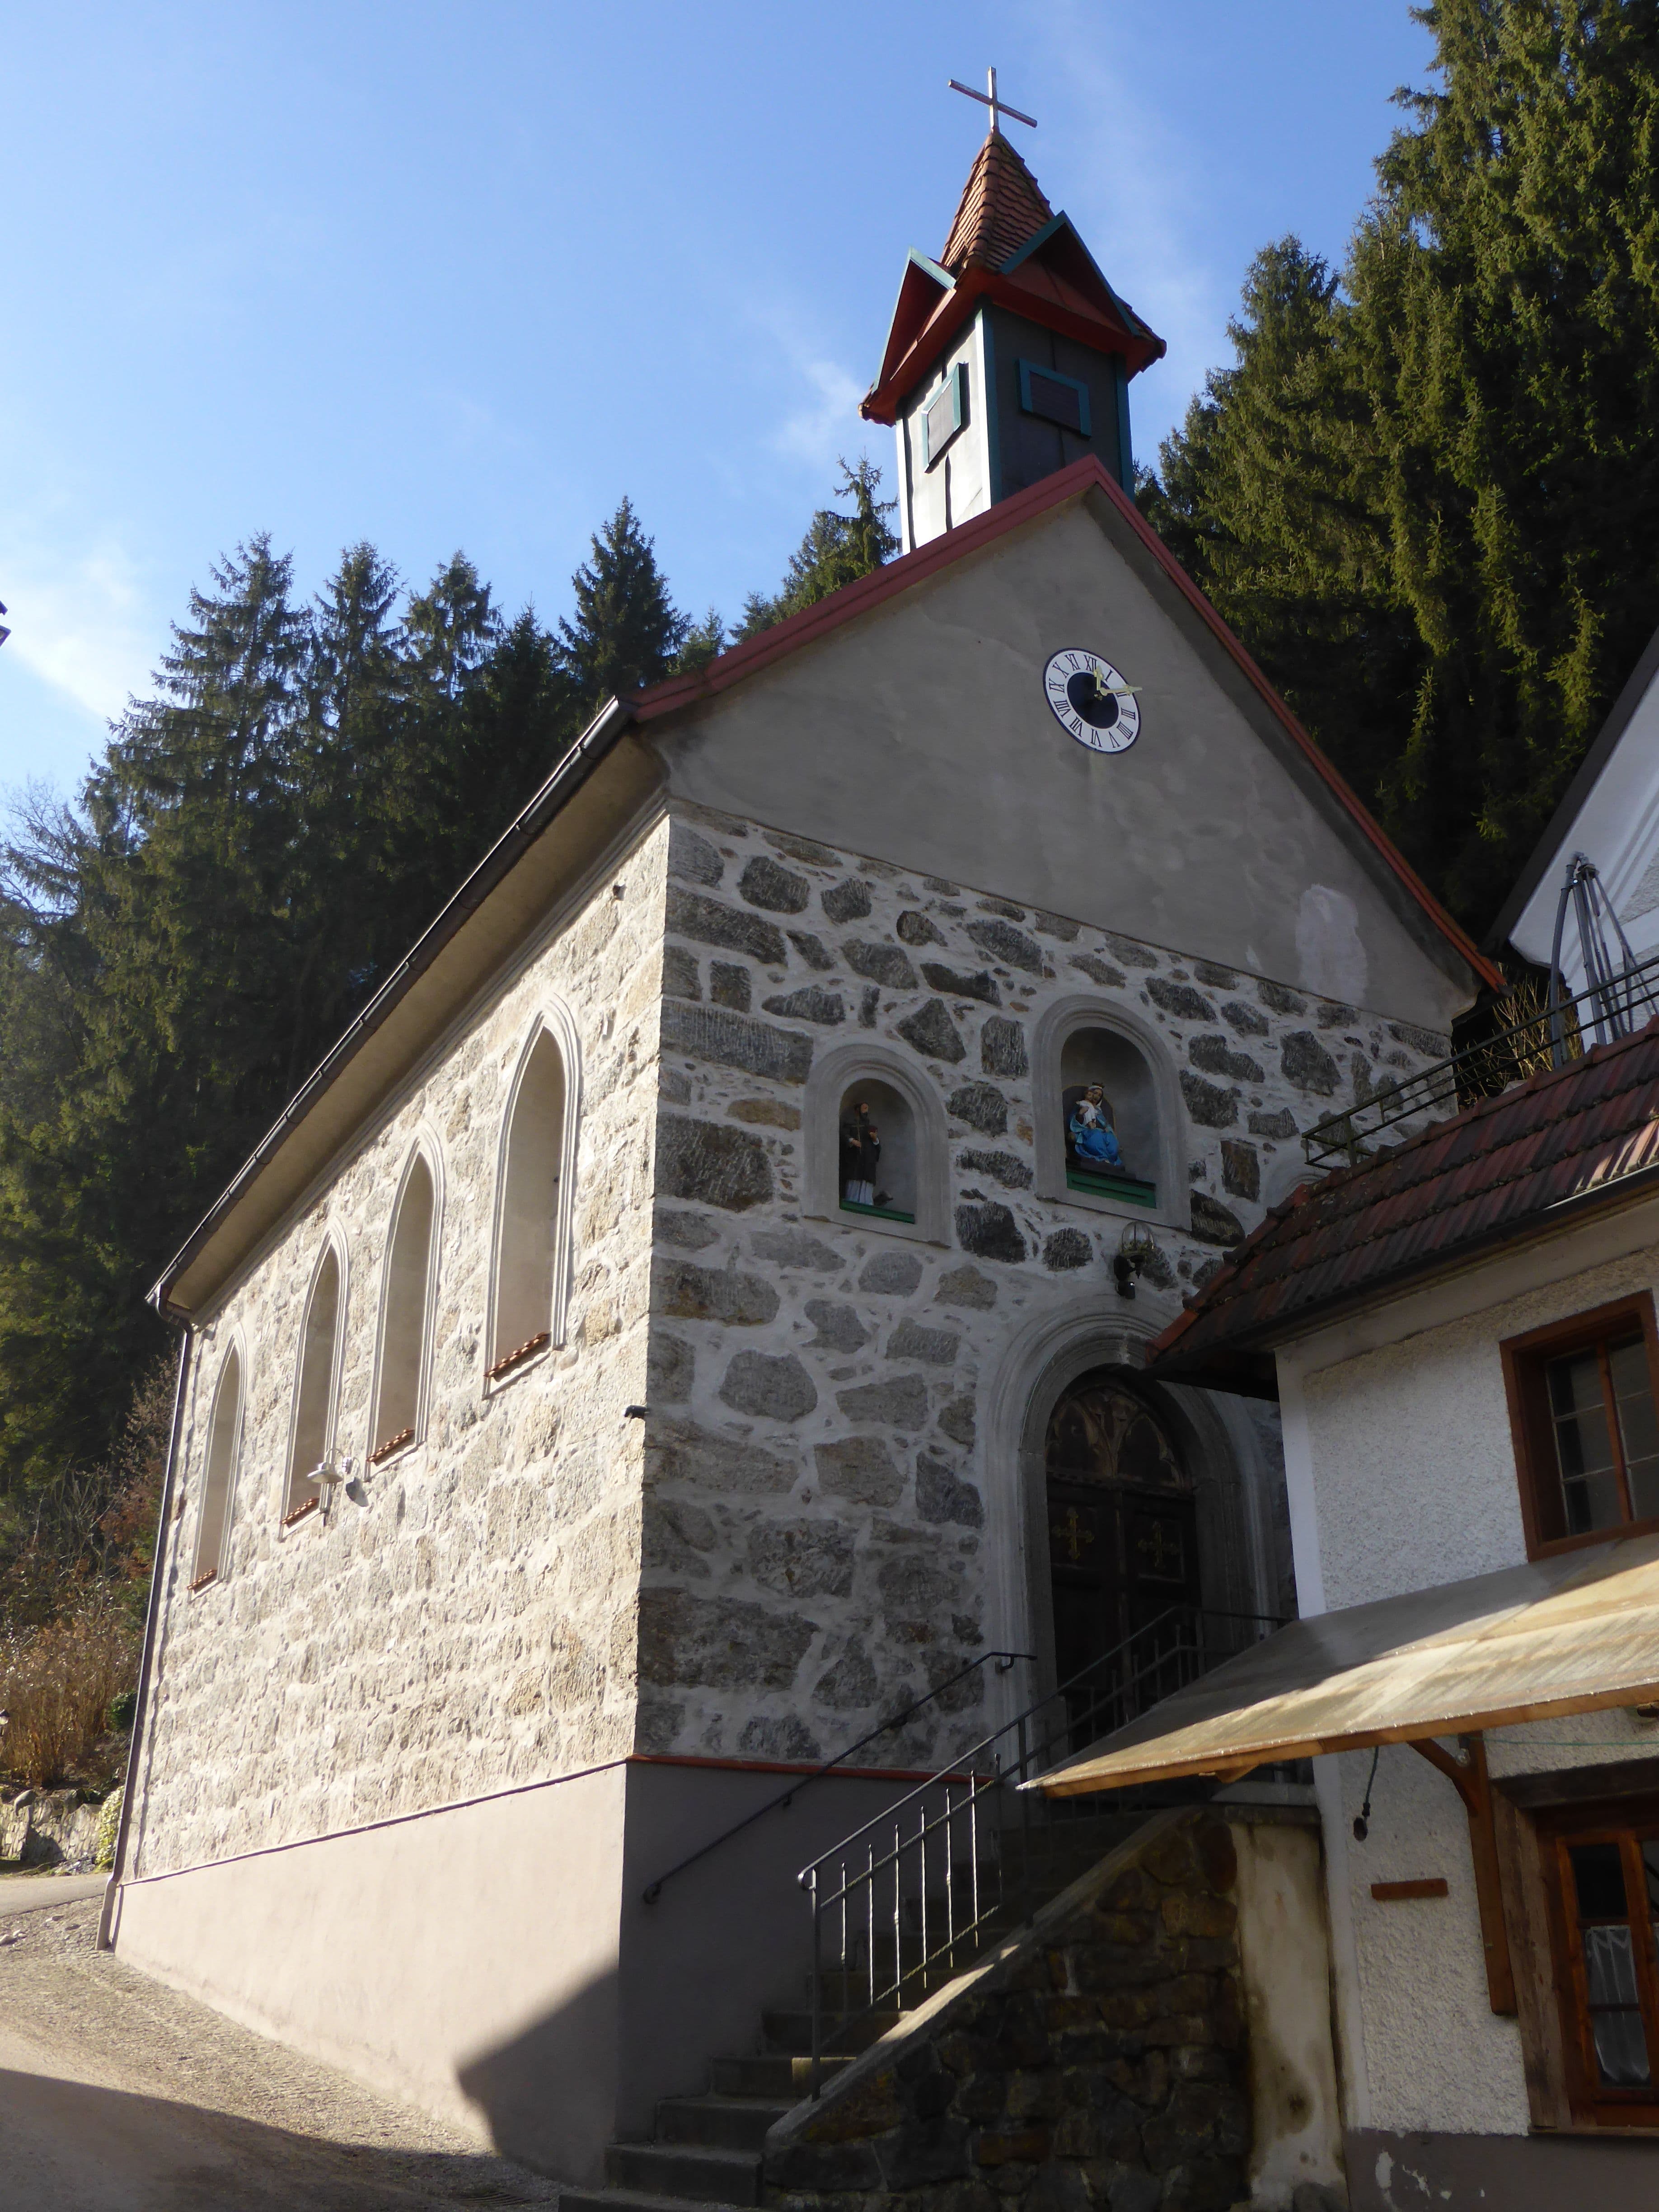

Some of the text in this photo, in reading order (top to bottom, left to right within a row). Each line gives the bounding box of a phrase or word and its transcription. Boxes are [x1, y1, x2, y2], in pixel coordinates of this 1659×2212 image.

[1052, 661, 1069, 679] X
[1064, 654, 1081, 671] XI
[1083, 655, 1097, 672] XII
[1104, 669, 1113, 682] I
[1049, 678, 1065, 694] IX
[1053, 699, 1071, 718] VIII
[1121, 707, 1136, 721] III
[1069, 716, 1082, 737] VII
[1116, 721, 1134, 740] IIII
[1090, 728, 1103, 748] VI
[1108, 731, 1120, 748] V
